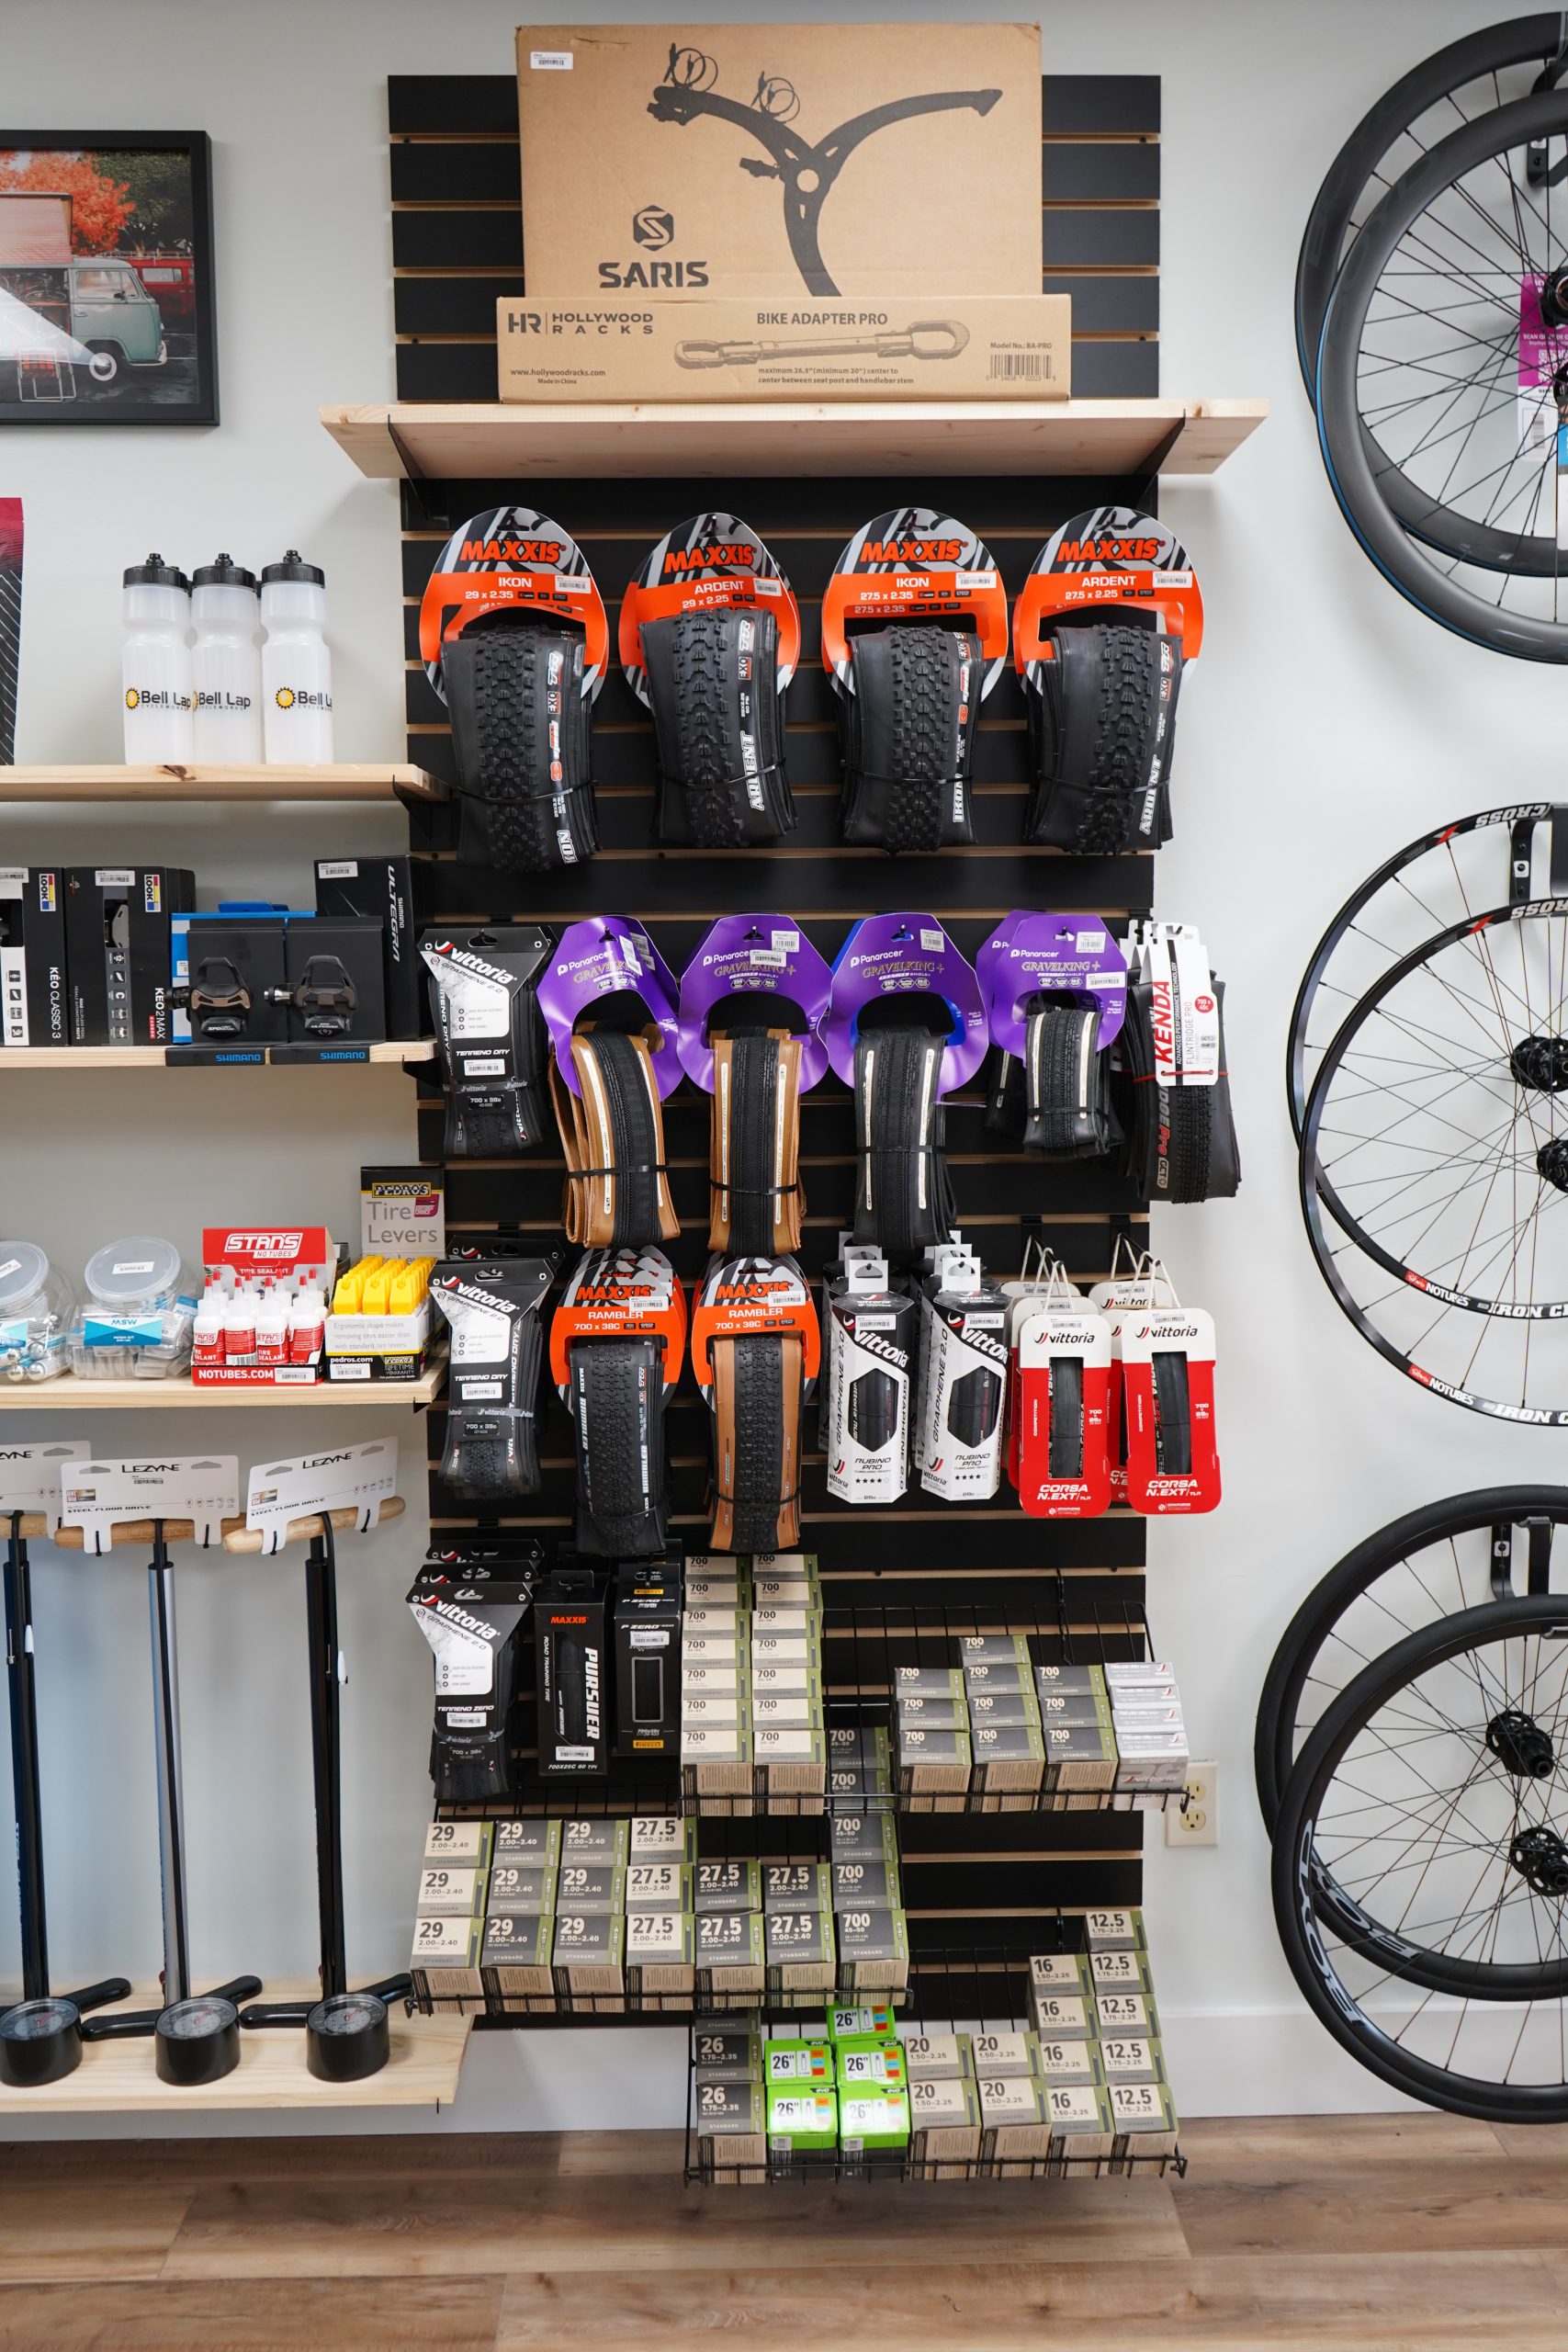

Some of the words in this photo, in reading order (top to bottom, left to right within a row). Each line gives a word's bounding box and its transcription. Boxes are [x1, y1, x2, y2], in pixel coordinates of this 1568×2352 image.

[598, 261, 708, 288] SARIS
[508, 312, 542, 334] HR
[552, 312, 653, 322] HOLLYWOOD
[757, 312, 788, 325] BIKE
[791, 312, 856, 325] ADAPTER
[859, 312, 888, 325] PRO
[552, 324, 653, 334] RACKS
[511, 368, 606, 377] www.hollywoodracks.com
[782, 376, 812, 384] between
[829, 377, 845, 385] post
[845, 376, 859, 384] and
[860, 376, 896, 384] handlebar
[459, 539, 560, 563] MAXXIS
[859, 538, 962, 563] MAXXIS
[1056, 538, 1159, 562] MAXXIS
[663, 544, 754, 574] MAXXIS
[498, 577, 532, 588] IKON
[694, 581, 744, 595] ARDENT
[896, 577, 930, 588] IKON
[1081, 576, 1137, 588] ARDENT
[465, 591, 479, 600] 29
[490, 591, 513, 599] 2.35
[682, 599, 696, 609] 29
[706, 594, 729, 605] 2.25
[860, 592, 881, 601] 27.5
[890, 591, 914, 600] 2.35
[1065, 591, 1086, 600] 27.5
[1095, 589, 1119, 599] 2.25
[141, 691, 169, 705] Bell
[173, 692, 192, 711] Lap
[198, 691, 221, 706] Bell
[226, 692, 251, 710] Lap
[298, 691, 323, 706] Bell
[1474, 802, 1549, 829] CROSS
[40, 875, 50, 901] LOOK
[145, 876, 155, 901] LOOK
[387, 865, 400, 963] ULTEGRA
[397, 897, 405, 929] SHIMANO
[860, 950, 904, 964] Panaracer
[1021, 949, 1059, 958] Panaracer
[450, 946, 516, 985] vittoria
[50, 989, 62, 1031] CLASSIC
[1152, 981, 1173, 1065] KENDA
[1185, 1019, 1194, 1065] FLINTRIDGE
[215, 1054, 262, 1062] SHIMANO
[320, 1051, 366, 1060] SHIMANO
[367, 1201, 412, 1221] Tire
[368, 1225, 438, 1244] Levers
[457, 1281, 517, 1314] vittoria
[575, 1285, 651, 1302] MAXXIS
[716, 1281, 790, 1300] MAXXIS
[1425, 1282, 1470, 1308] NOTUBES
[588, 1310, 644, 1319] RAMBLER
[728, 1307, 784, 1318] RAMBLER
[1488, 1302, 1543, 1318] IRON
[716, 1321, 734, 1330] 700
[742, 1320, 761, 1329] 38C
[1150, 1326, 1199, 1339] vittoria
[1049, 1331, 1096, 1344] vittoria
[854, 1329, 908, 1368] vittoria
[330, 1356, 374, 1364] pedros.com
[198, 1369, 274, 1380] NOTUBES.COM
[454, 1374, 491, 1383] TERRENO
[491, 1373, 509, 1381] DRY
[1428, 1377, 1476, 1406] NOTUBES
[1491, 1402, 1552, 1424] IRON
[302, 1452, 354, 1470] LEZYNE
[954, 1453, 991, 1461] RUBINO
[121, 1463, 181, 1474] LEZYNE
[1039, 1484, 1089, 1494] CORSA
[1147, 1479, 1199, 1488] CORSA
[690, 1556, 708, 1566] 700
[756, 1554, 775, 1564] 700
[435, 1600, 499, 1641] vittoria
[550, 1616, 587, 1624] MAXXIS
[686, 1640, 705, 1649] 700
[964, 1636, 985, 1646] 700
[899, 1668, 919, 1678] 700
[584, 1646, 601, 1740] PURSUER
[758, 1700, 778, 1709] 700
[686, 1732, 706, 1741] 700
[829, 1729, 856, 1742] 700
[1049, 1729, 1070, 1741] 700
[432, 1826, 455, 1842] 29
[499, 1822, 524, 1838] 29
[567, 1822, 592, 1838] 29
[636, 1820, 676, 1837] 27.5
[424, 1871, 449, 1888] 29
[494, 1869, 519, 1885] 29
[563, 1869, 588, 1884] 29
[631, 1868, 672, 1884] 27.5
[699, 1864, 740, 1883] 27.5
[768, 1867, 810, 1884] 27.5
[837, 1865, 864, 1879] 700
[488, 1918, 513, 1936] 29
[559, 1917, 585, 1935] 29
[632, 1917, 674, 1935] 27.5
[700, 1917, 742, 1937] 27.5
[771, 1915, 813, 1934] 27.5
[1089, 1913, 1125, 1928] 12.5
[418, 1921, 444, 1939] 29
[1033, 1958, 1054, 1973] 16
[1094, 1955, 1131, 1971] 12.5
[1040, 2000, 1060, 2016] 16
[1100, 1997, 1137, 2014] 12.5
[701, 2037, 724, 2054] 26
[908, 2038, 931, 2053] 20
[976, 2036, 998, 2052] 20
[1105, 2042, 1143, 2059] 12.5
[1043, 2045, 1064, 2061] 16
[701, 2086, 726, 2105] 26
[914, 2084, 935, 2099] 20
